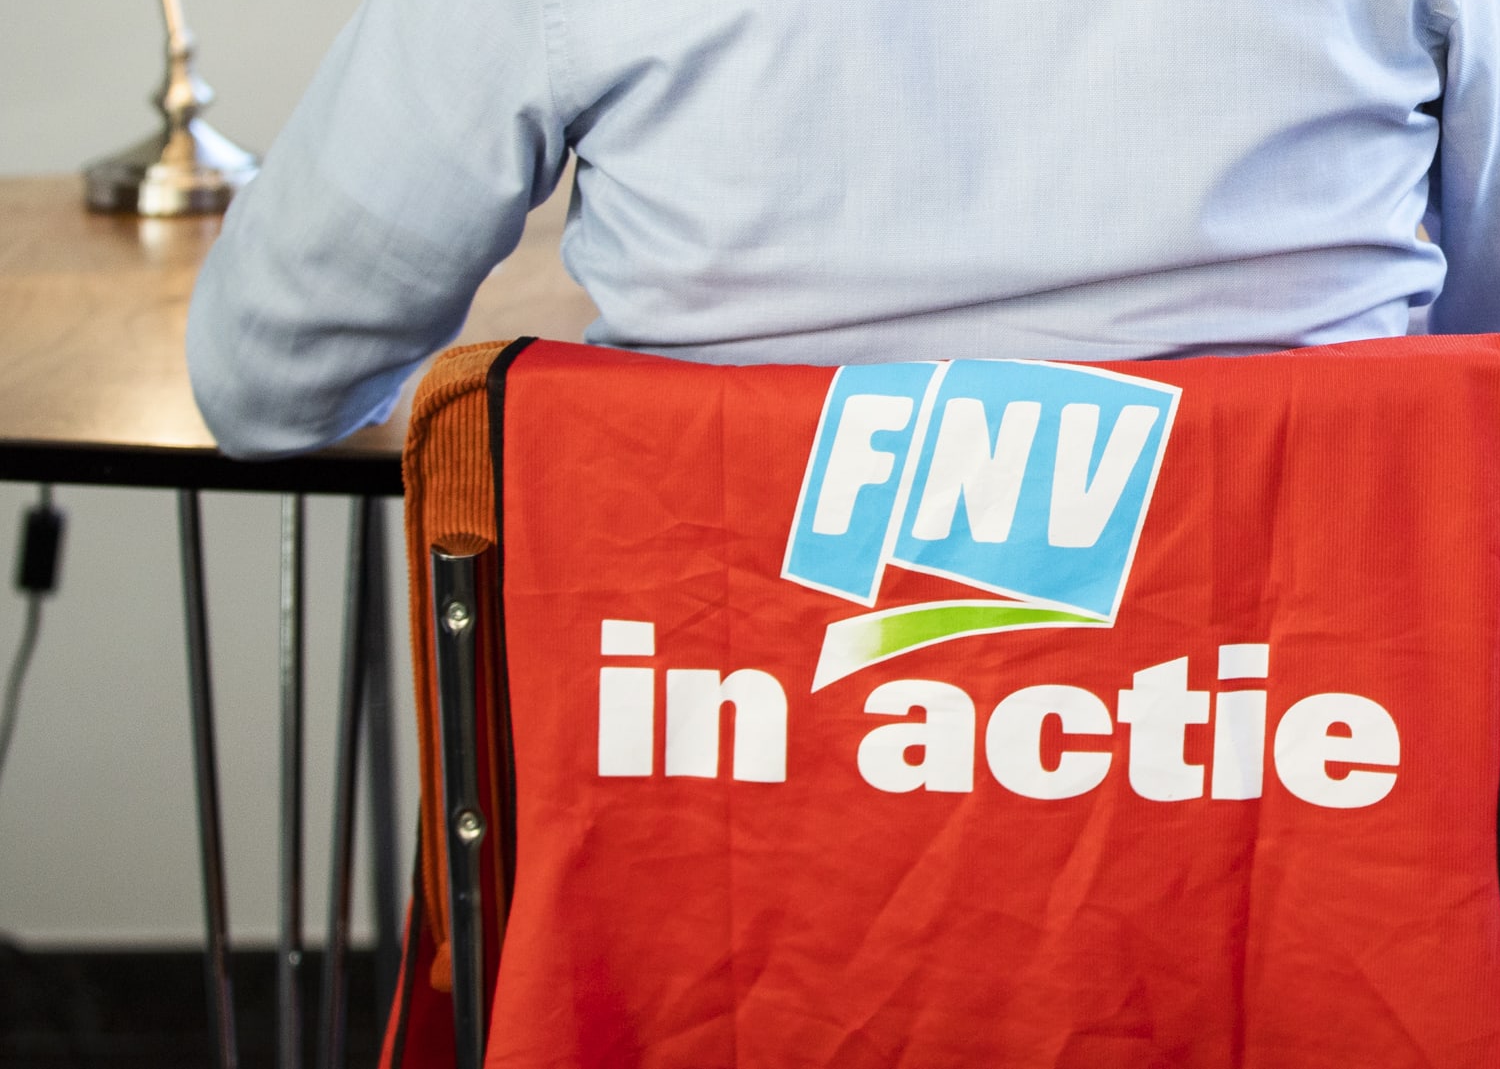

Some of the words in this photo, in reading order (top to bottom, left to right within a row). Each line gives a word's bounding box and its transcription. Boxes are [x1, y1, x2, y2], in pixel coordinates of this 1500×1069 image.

[811, 392, 1162, 549] FNV
[598, 619, 788, 783] in
[857, 643, 1401, 809] actie
